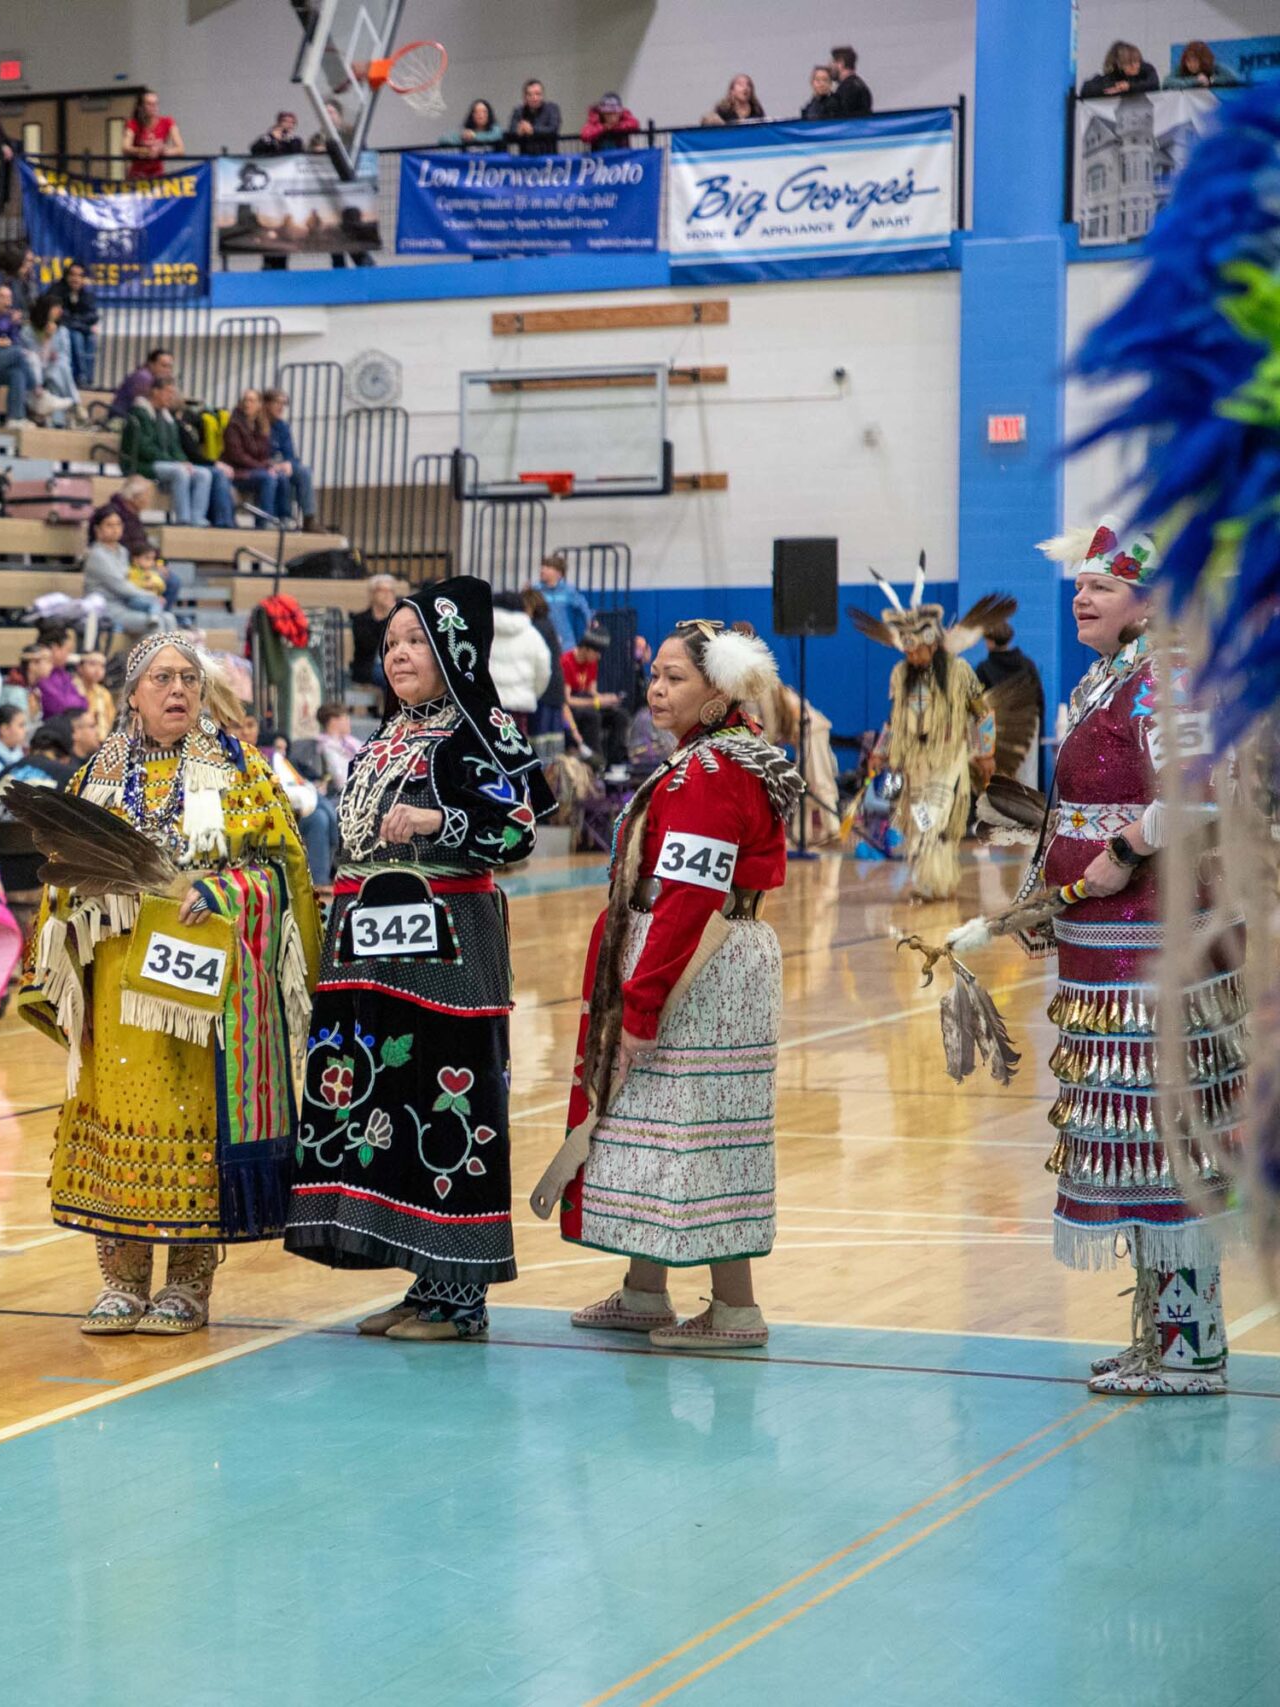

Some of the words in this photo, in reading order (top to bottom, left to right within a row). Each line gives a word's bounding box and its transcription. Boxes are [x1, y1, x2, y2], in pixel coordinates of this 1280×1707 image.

[417, 159, 460, 188] Lon
[464, 158, 571, 188] Horwedel
[576, 157, 645, 187] Photo
[686, 174, 768, 238] Big
[686, 231, 727, 241] HOME
[761, 222, 836, 236] APPLIANCE
[871, 215, 912, 229] MART
[661, 842, 734, 883] 345
[356, 914, 433, 949] 342
[148, 943, 220, 987] 354
